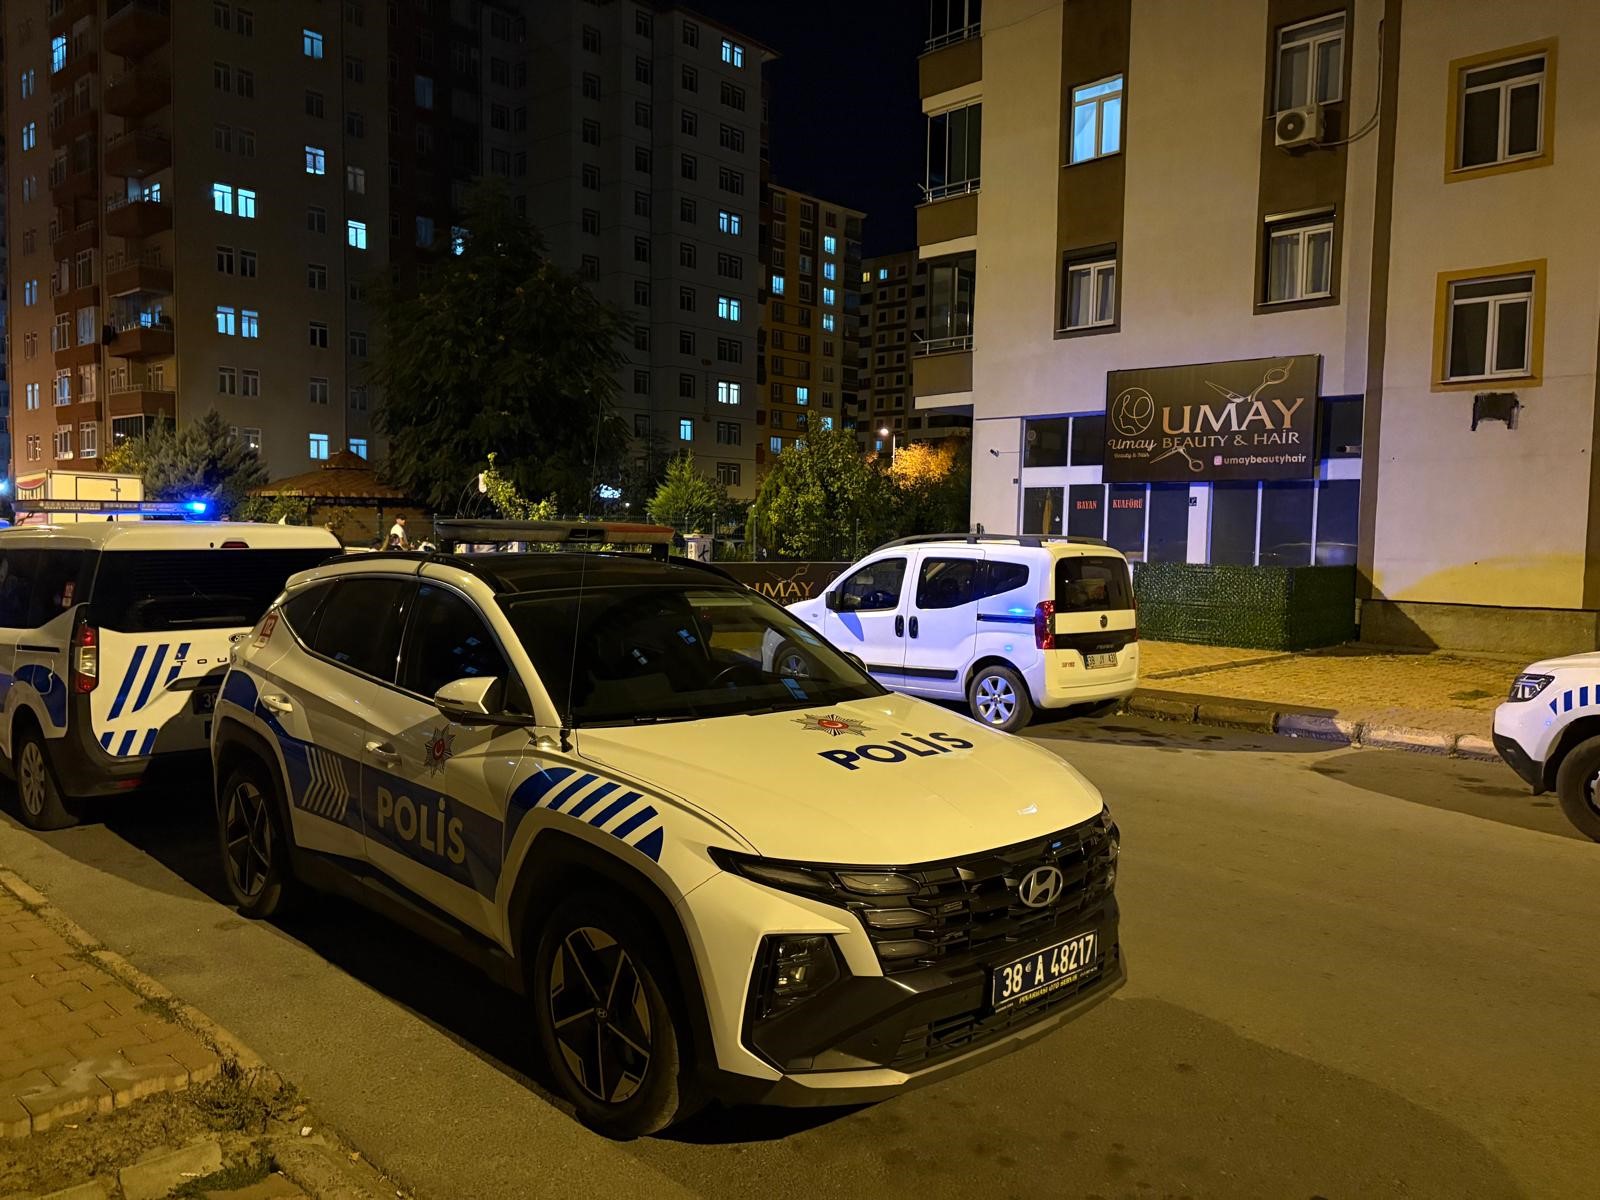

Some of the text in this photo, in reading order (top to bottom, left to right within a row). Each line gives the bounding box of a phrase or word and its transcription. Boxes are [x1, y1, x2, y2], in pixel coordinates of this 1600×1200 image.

[1162, 398, 1305, 434] UMAY
[1107, 438, 1158, 452] Umay
[1162, 434, 1228, 449] BEAUTY
[1233, 434, 1248, 446] &
[1223, 453, 1307, 467] umaybeautyhair
[1076, 497, 1143, 510] BAYAN KUAFÖRÜ
[177, 657, 227, 666] TOU
[817, 731, 974, 771] POLİS
[375, 785, 466, 865] POLİS
[1002, 933, 1094, 997] 38 A 48217
